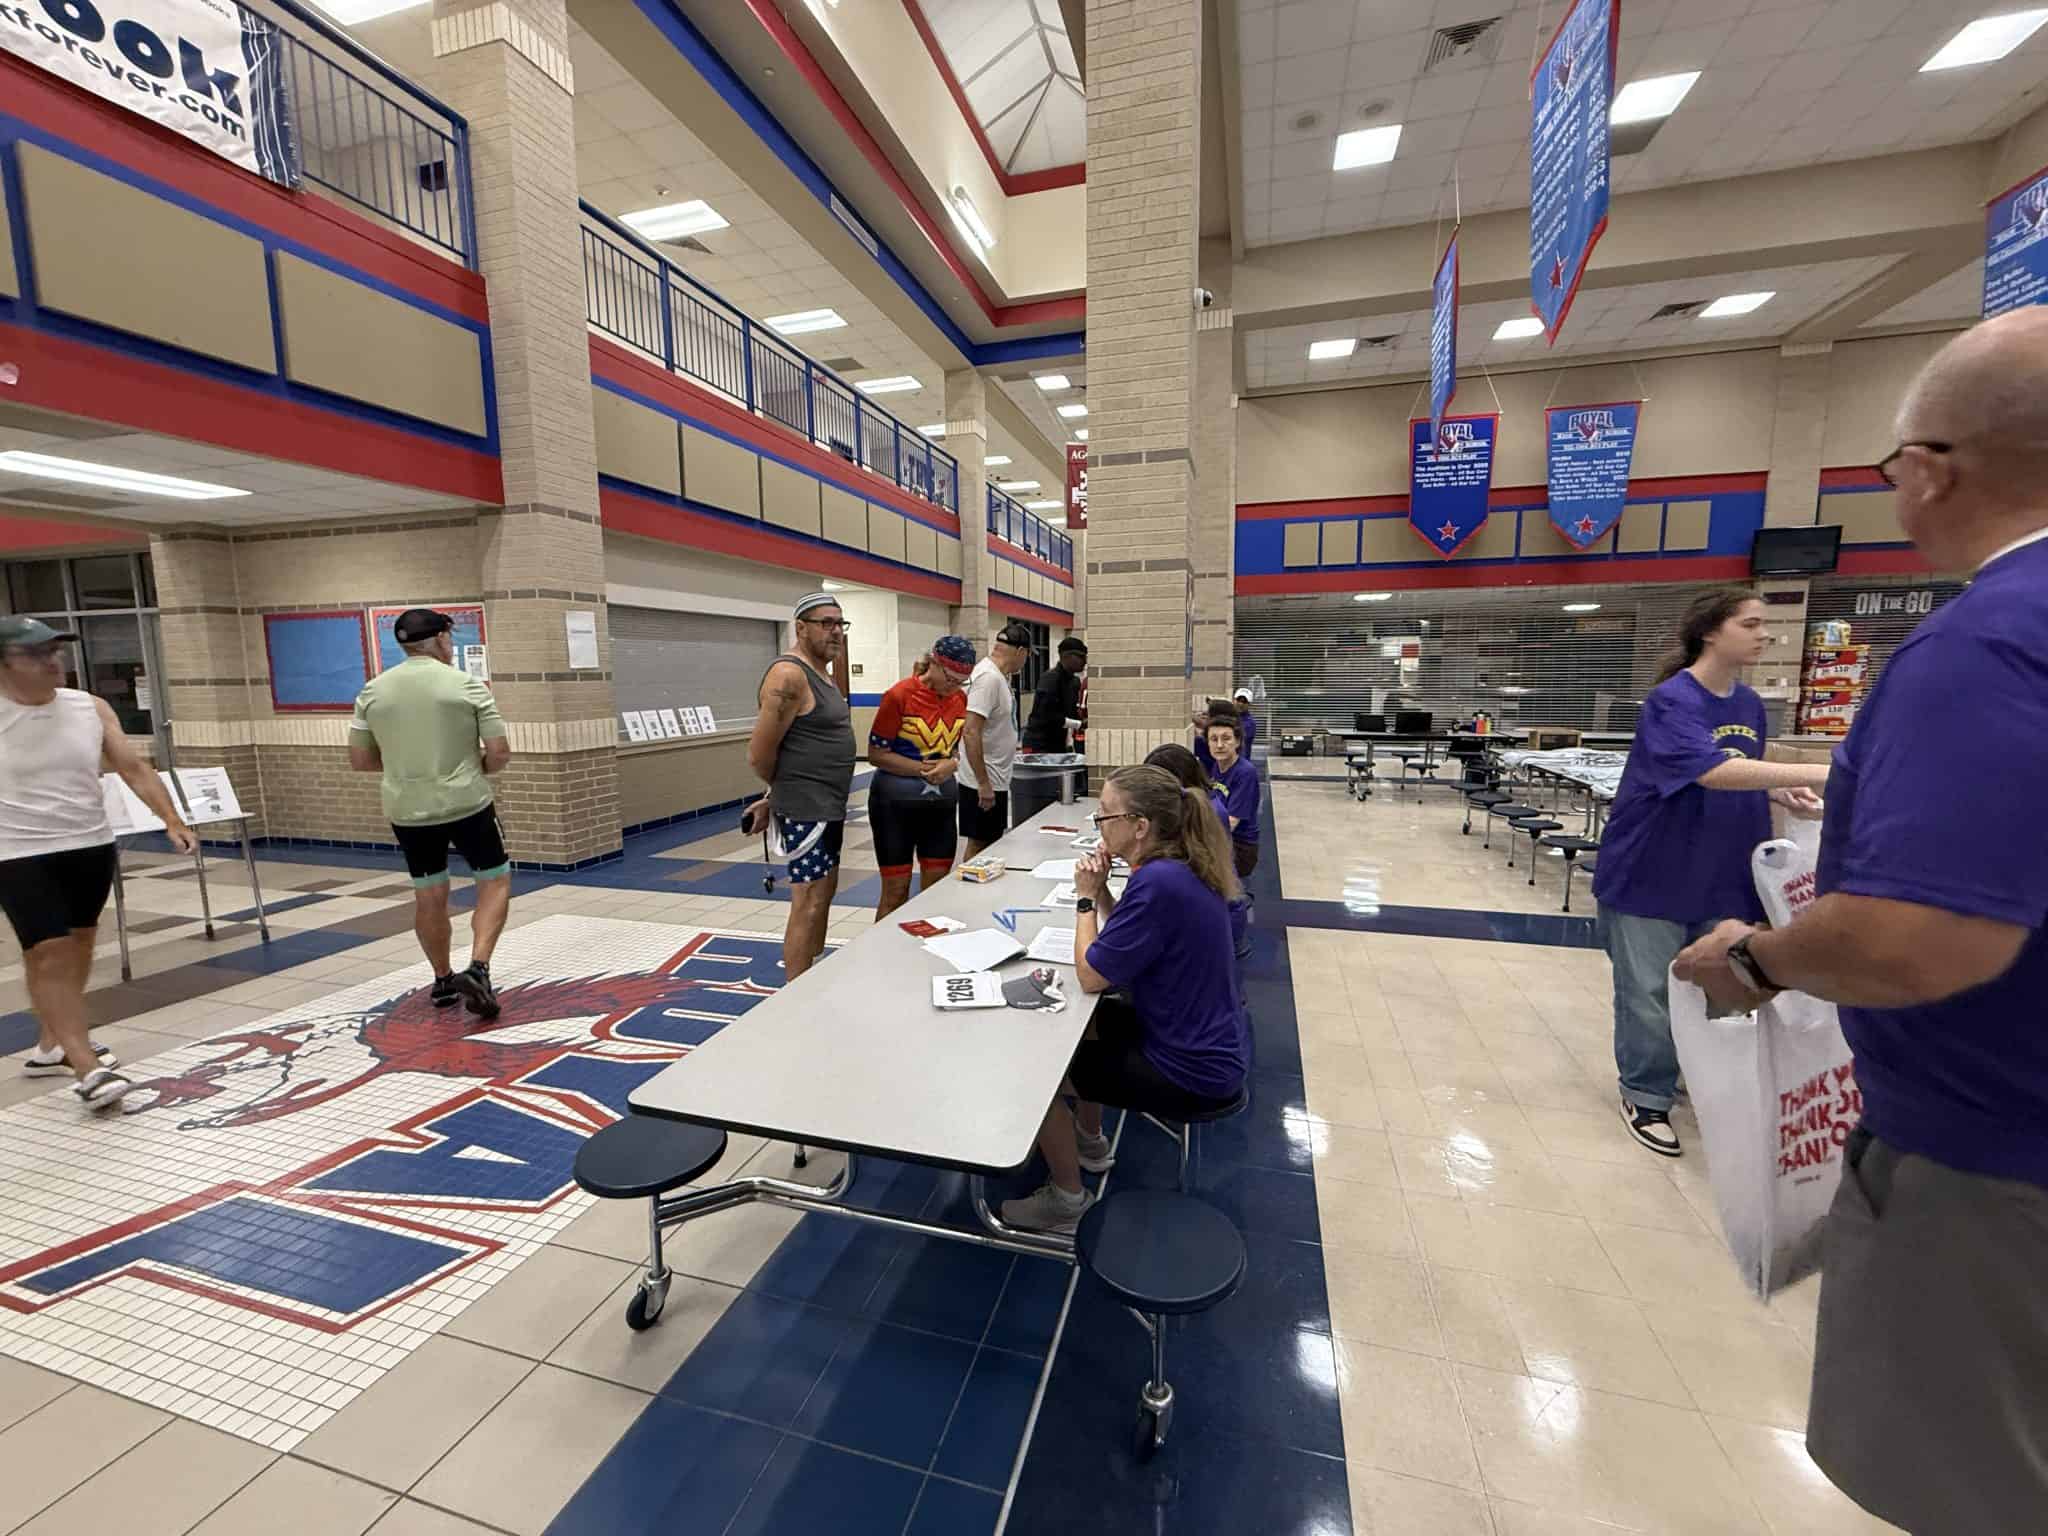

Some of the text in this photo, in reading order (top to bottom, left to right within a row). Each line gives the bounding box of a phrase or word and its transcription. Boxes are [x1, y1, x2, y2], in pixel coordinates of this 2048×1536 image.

[1855, 593, 1882, 614] ON
[1905, 592, 1932, 613] GO
[946, 977, 975, 1003] 1269
